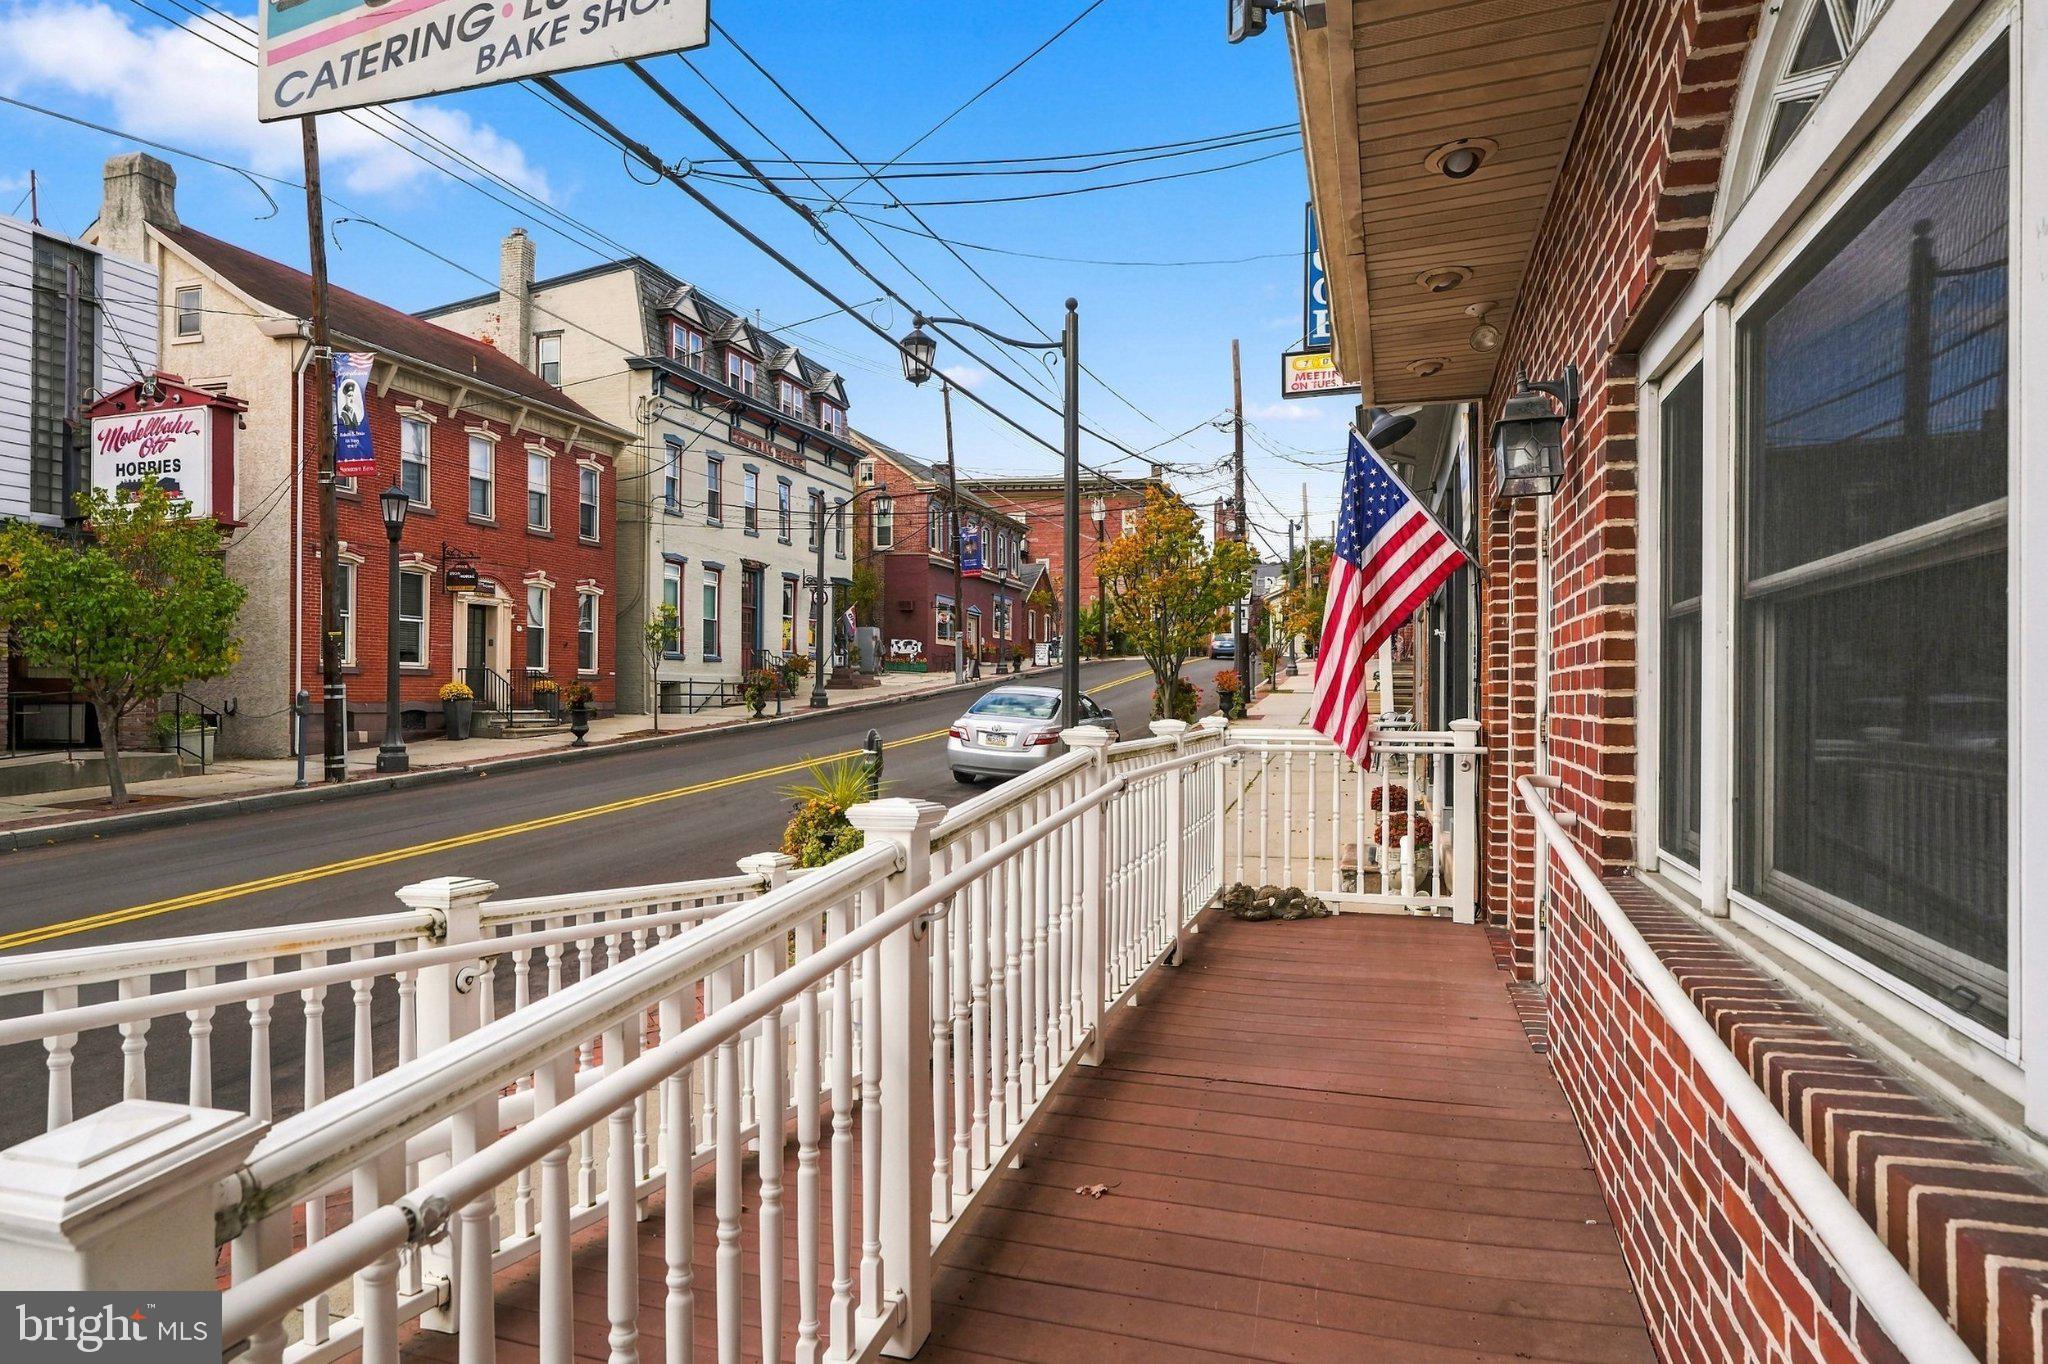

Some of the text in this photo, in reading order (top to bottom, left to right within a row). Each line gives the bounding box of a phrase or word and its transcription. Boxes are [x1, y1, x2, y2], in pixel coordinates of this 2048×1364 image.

[476, 0, 671, 75] BAKE SHO
[275, 3, 495, 108] CATERING
[1291, 381, 1308, 391] ON
[1311, 380, 1339, 389] TUES.
[1295, 371, 1341, 382] MEETIN
[97, 414, 200, 455] Modellbahn
[138, 435, 177, 458] Ott
[116, 459, 181, 477] HOBBIES
